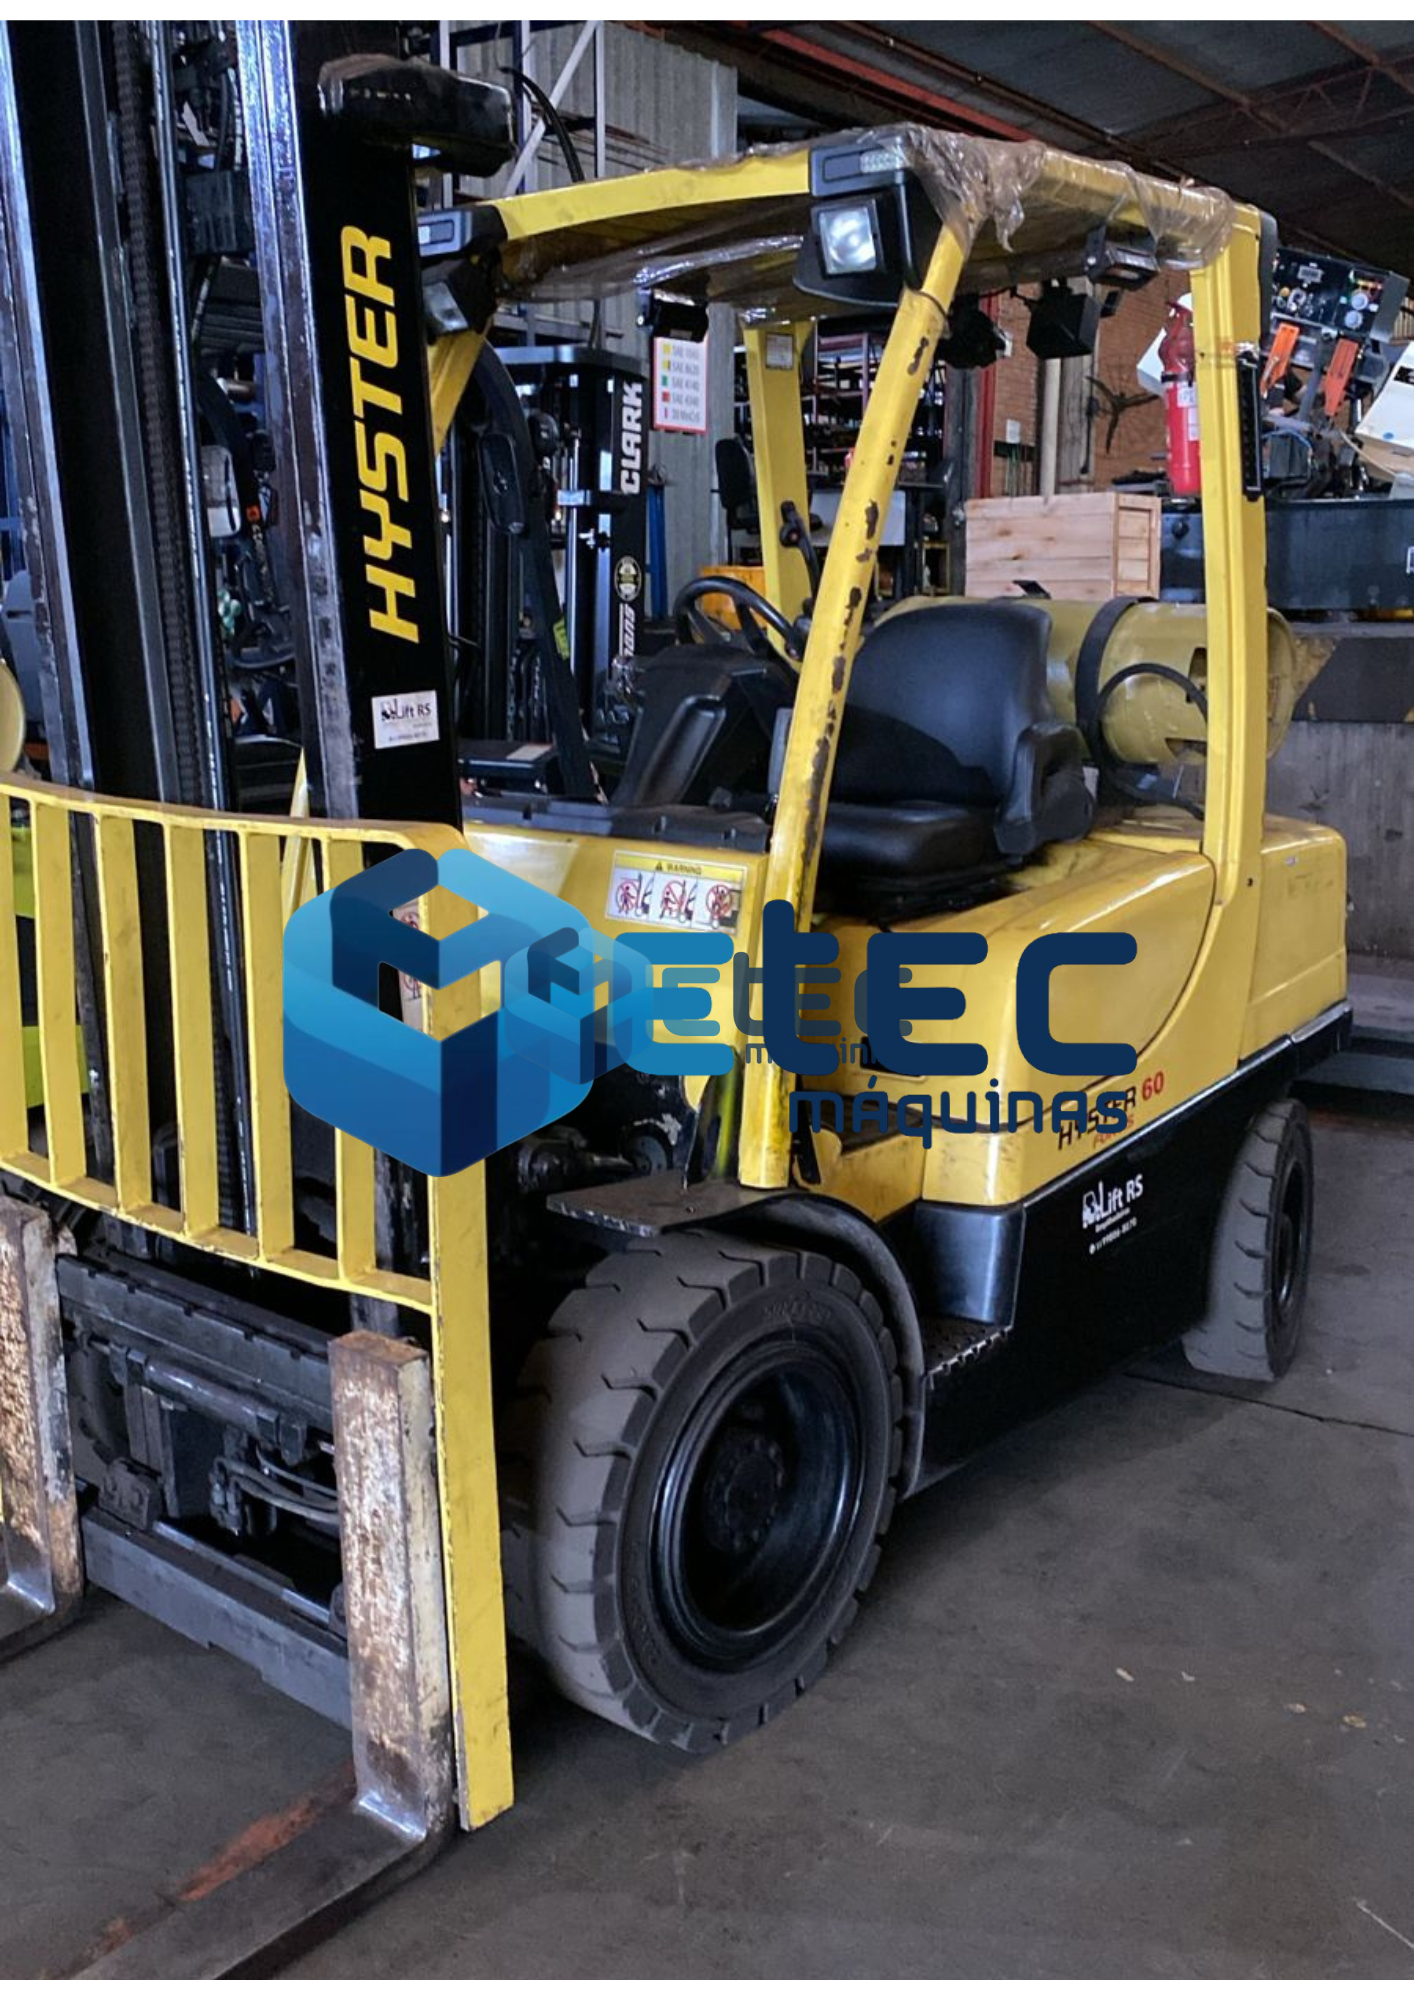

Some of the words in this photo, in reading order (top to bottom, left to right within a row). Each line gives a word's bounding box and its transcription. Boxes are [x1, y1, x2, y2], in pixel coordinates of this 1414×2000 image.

[341, 225, 419, 643] HYSTER
[621, 381, 643, 494] CLARK
[667, 863, 702, 875] WARNING
[1142, 1071, 1164, 1101] 60
[1126, 1173, 1144, 1203] RS
